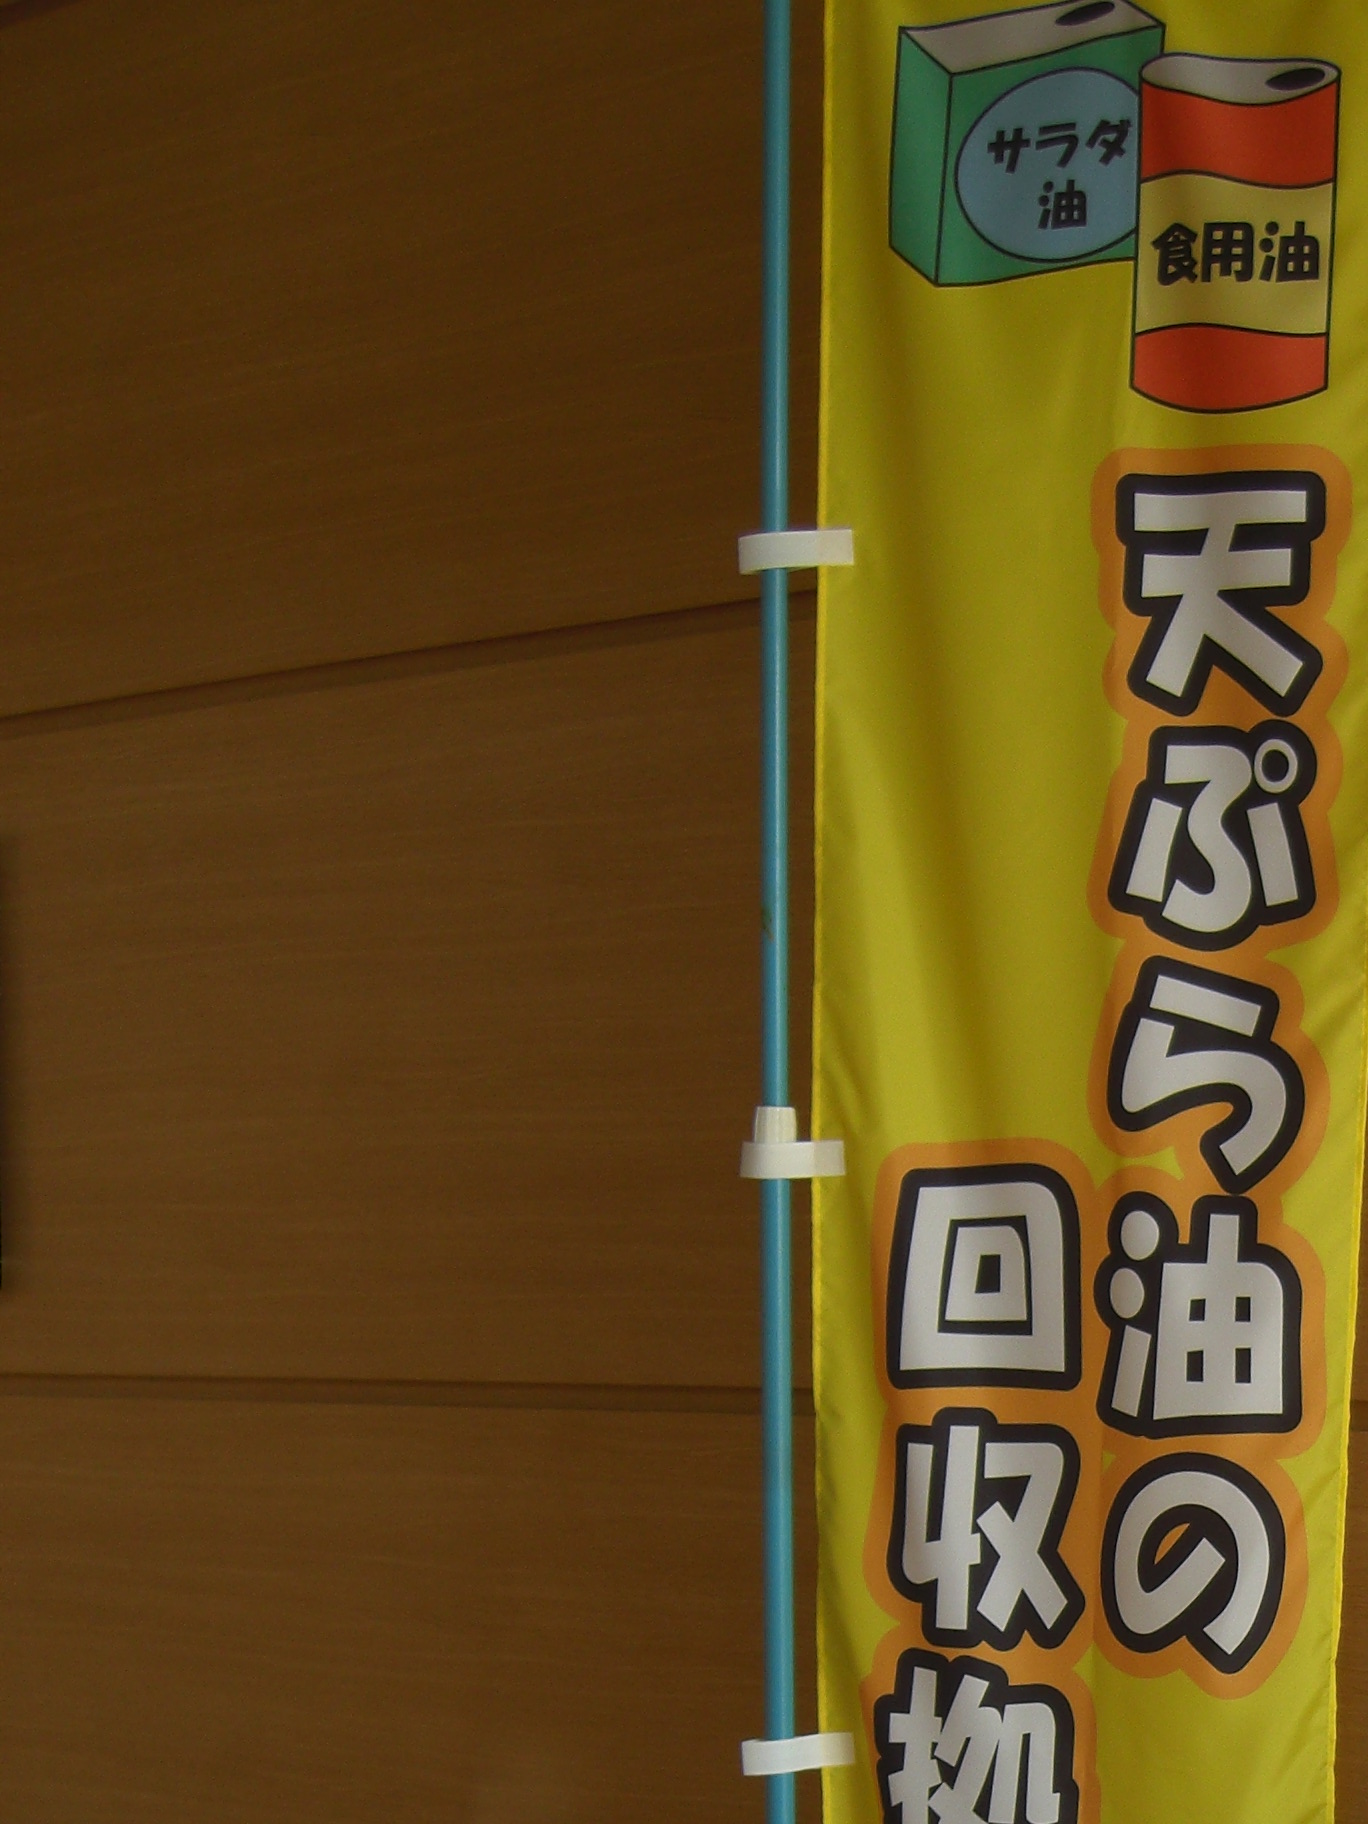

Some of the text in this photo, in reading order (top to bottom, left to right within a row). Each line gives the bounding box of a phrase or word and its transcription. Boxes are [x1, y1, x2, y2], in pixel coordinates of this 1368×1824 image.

[986, 119, 1132, 172] サラダ
[1036, 179, 1087, 230] 油
[1151, 219, 1321, 284] 食用油
[1096, 474, 1323, 1672] 天ぷら油の
